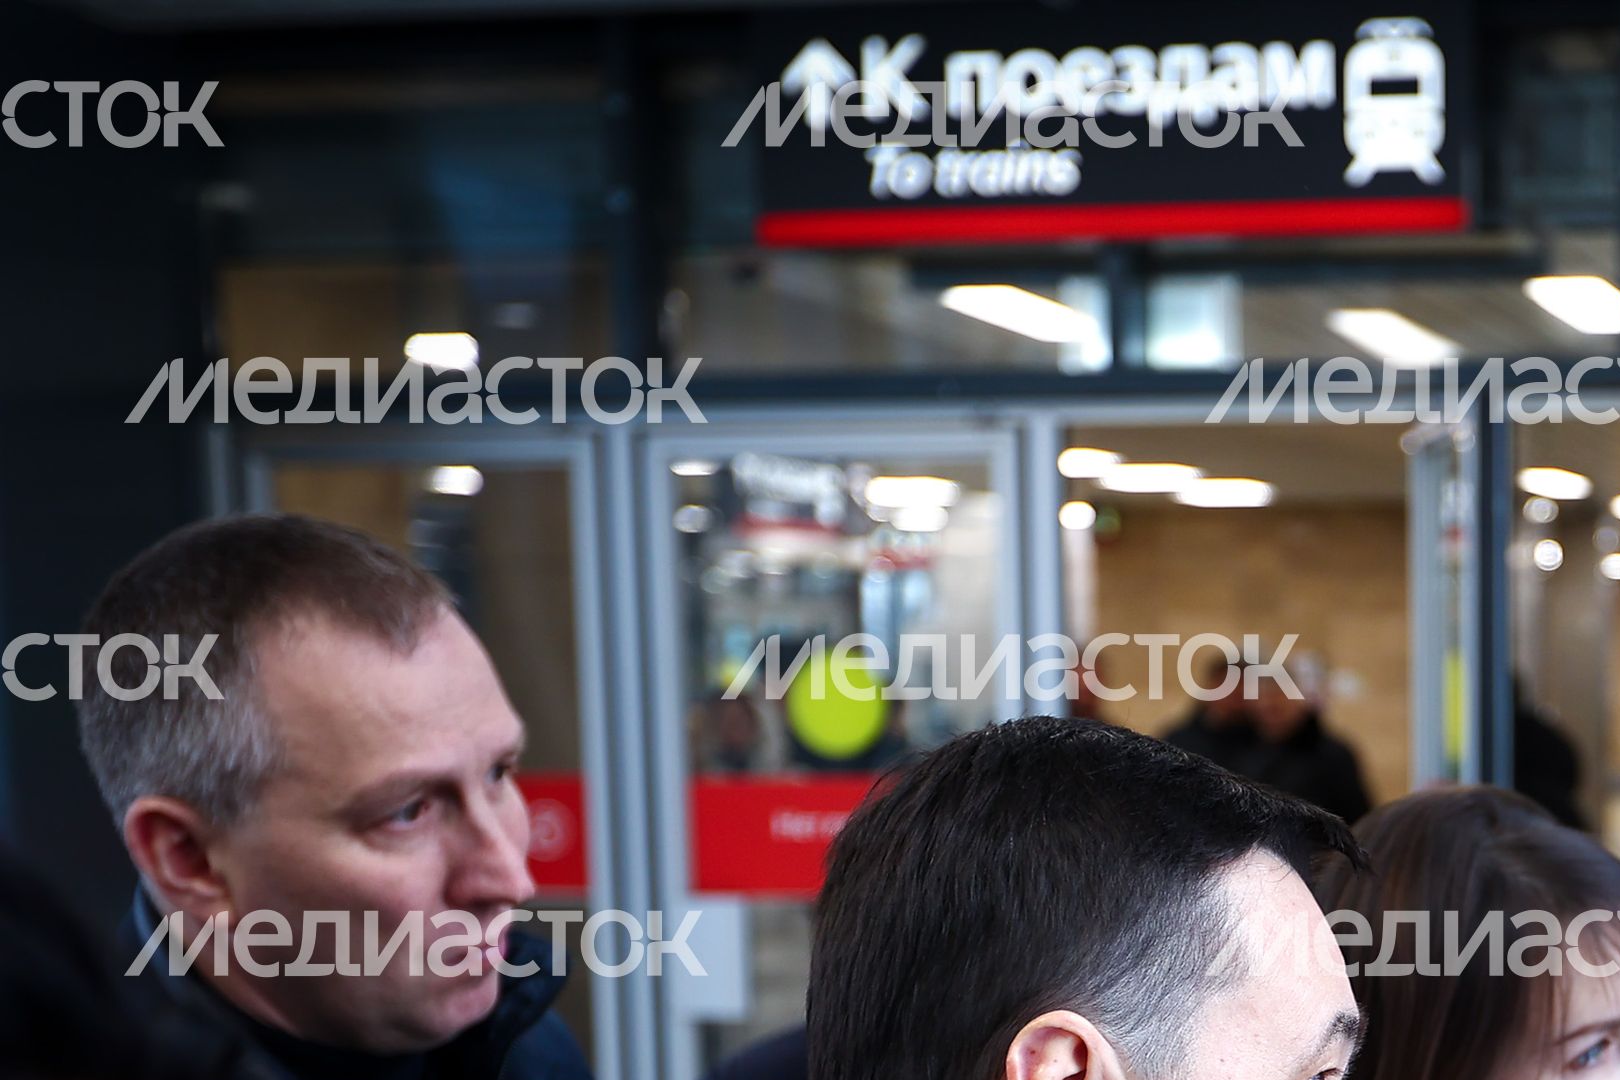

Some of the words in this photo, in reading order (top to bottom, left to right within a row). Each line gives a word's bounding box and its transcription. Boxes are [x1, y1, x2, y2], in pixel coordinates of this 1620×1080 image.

[861, 34, 928, 122] К
[943, 39, 1337, 130] поездам
[867, 143, 934, 200] To
[934, 138, 1083, 199] trains
